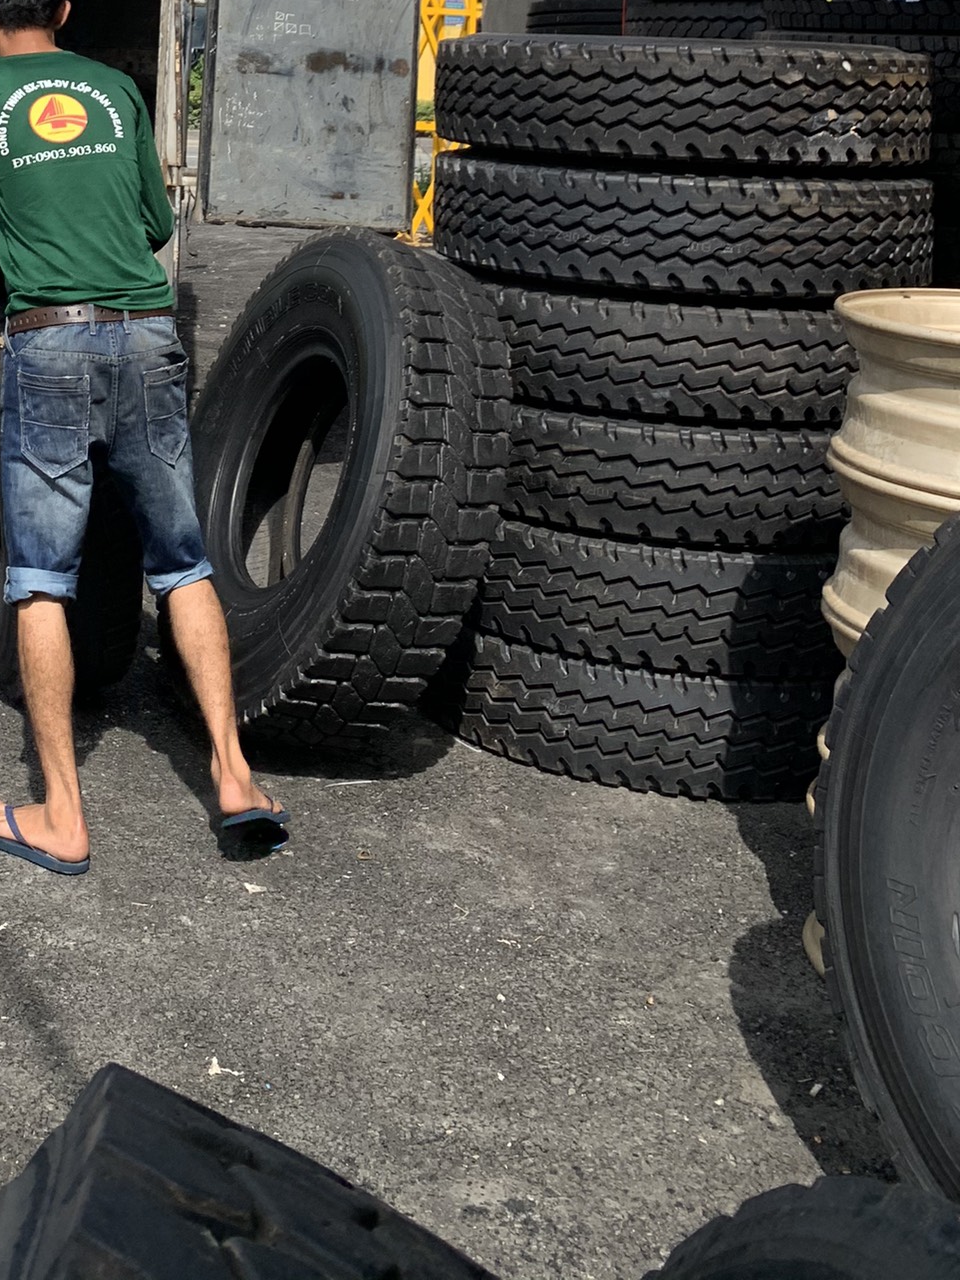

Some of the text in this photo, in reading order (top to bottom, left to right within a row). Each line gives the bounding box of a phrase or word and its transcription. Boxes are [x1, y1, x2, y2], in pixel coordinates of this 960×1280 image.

[3, 88, 26, 111] TNHH
[70, 81, 92, 93] LỐP
[106, 107, 124, 138] ASEAN
